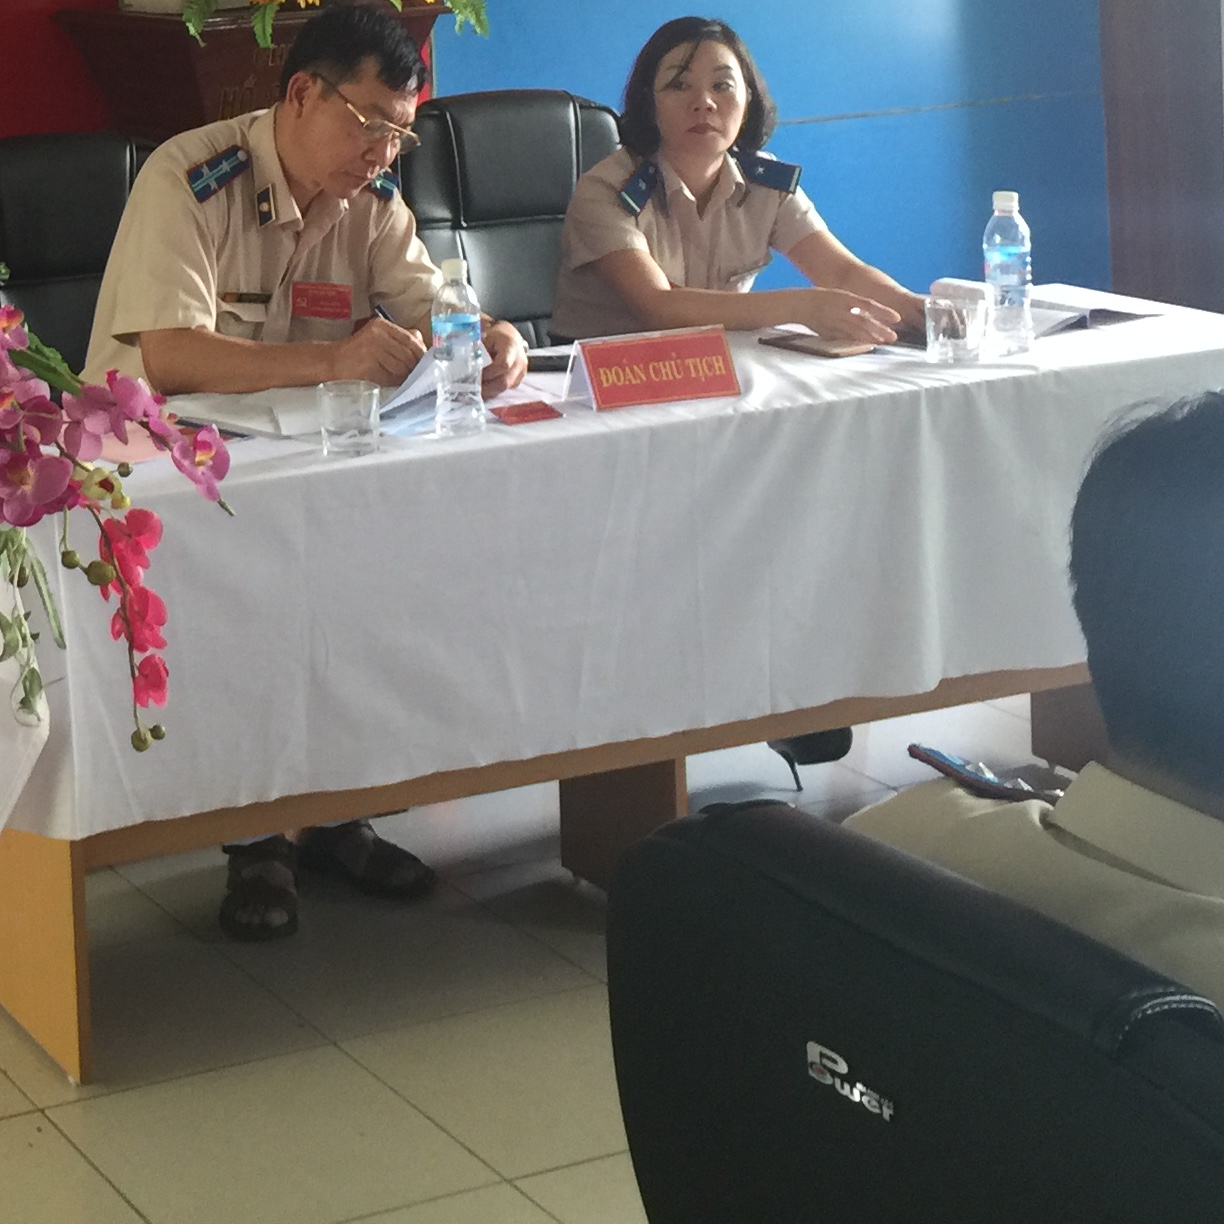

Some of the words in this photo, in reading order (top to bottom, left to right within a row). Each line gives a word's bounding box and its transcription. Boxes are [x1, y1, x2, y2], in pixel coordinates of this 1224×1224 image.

[598, 359, 647, 387] ĐOÀN
[649, 352, 682, 382] CHỦ
[685, 355, 726, 382] TỊCH
